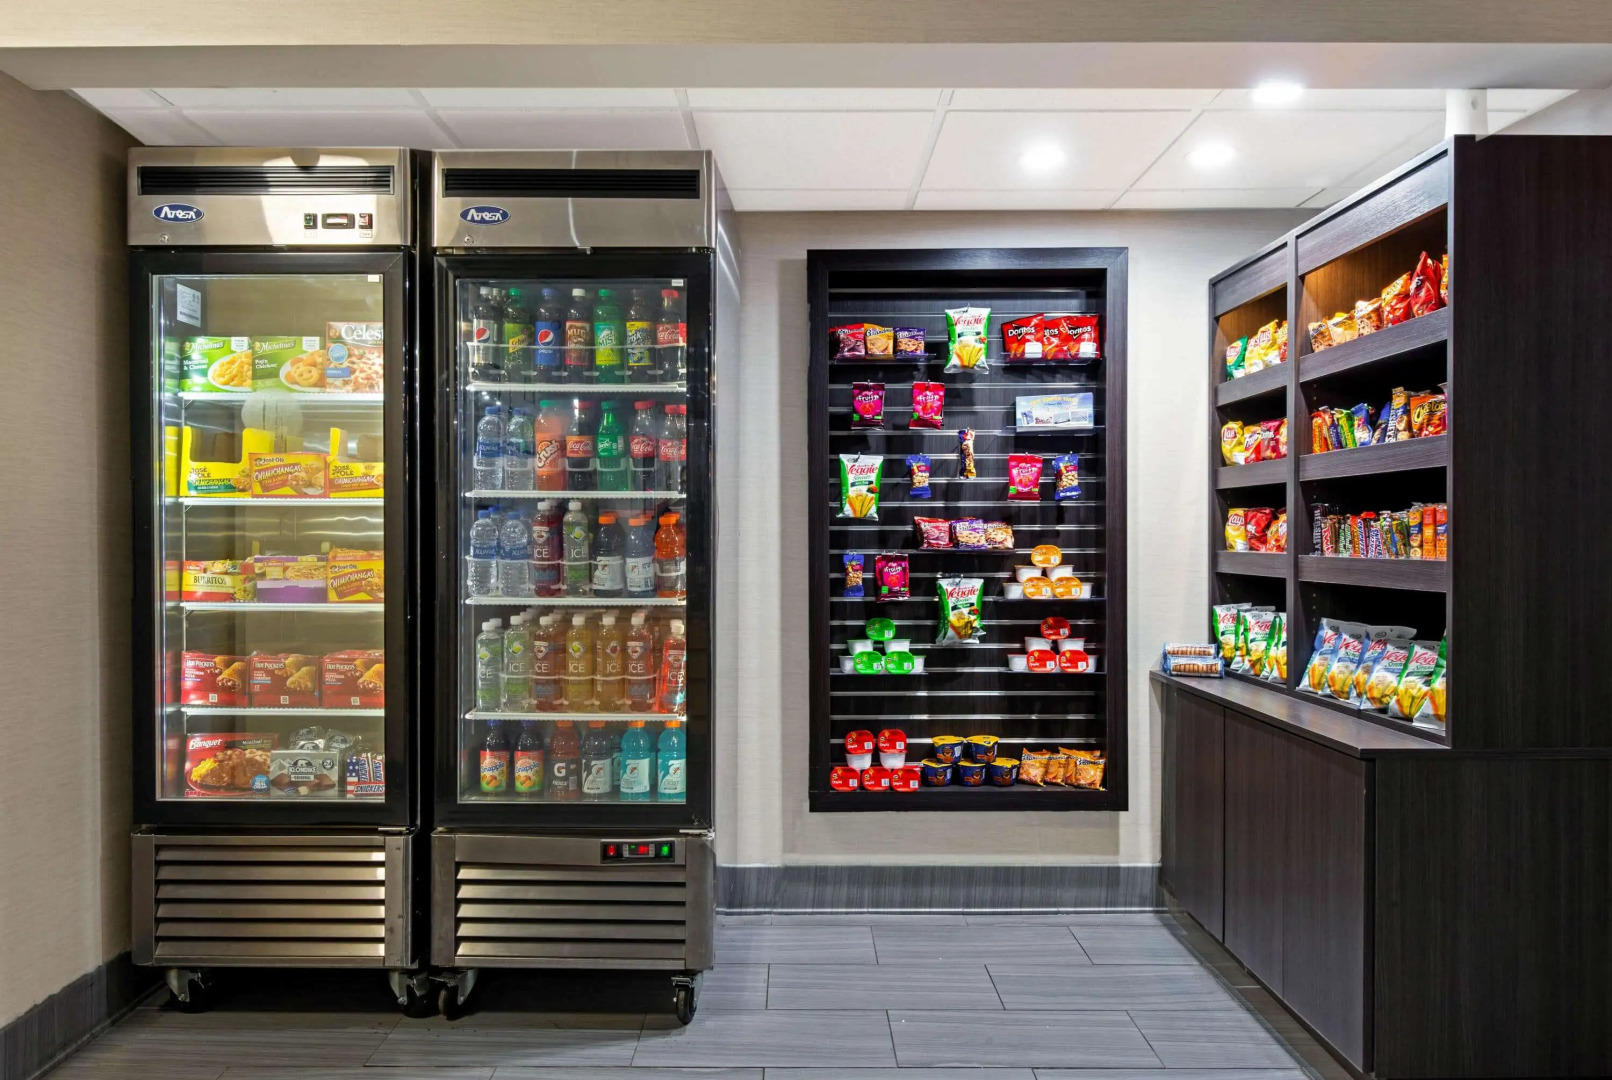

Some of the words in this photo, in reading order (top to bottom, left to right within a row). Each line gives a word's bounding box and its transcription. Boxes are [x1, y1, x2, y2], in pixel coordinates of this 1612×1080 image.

[1008, 326, 1035, 337] Doritos
[846, 463, 878, 476] Veggie
[534, 548, 550, 557] ICE
[193, 576, 226, 585] BURRITOS
[945, 586, 978, 600] Veggie
[509, 663, 525, 672] ICE
[569, 663, 585, 672] ICE
[629, 663, 644, 673] ICE
[189, 739, 222, 750] Banquet
[289, 765, 317, 773] KLONDIKE
[481, 761, 505, 773] Snapple
[516, 761, 540, 773] Snapple
[554, 762, 566, 777] G
[354, 784, 385, 793] SNICKERS
